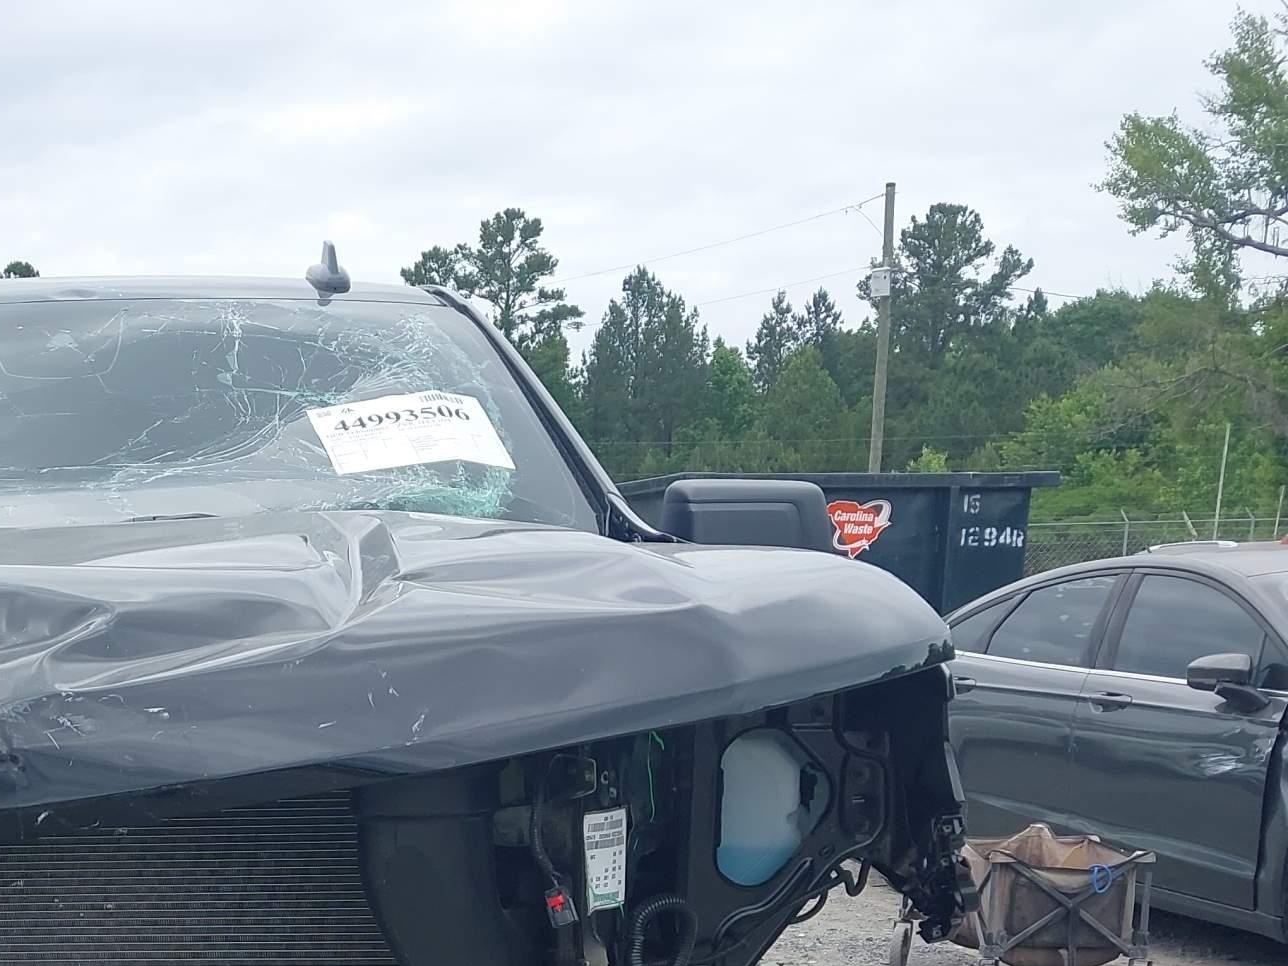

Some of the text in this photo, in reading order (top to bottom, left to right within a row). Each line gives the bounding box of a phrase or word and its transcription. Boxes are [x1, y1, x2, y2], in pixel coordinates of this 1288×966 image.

[334, 404, 470, 431] 44993506
[963, 494, 981, 515] 15
[834, 509, 874, 522] Carolina
[843, 522, 874, 534] Waste
